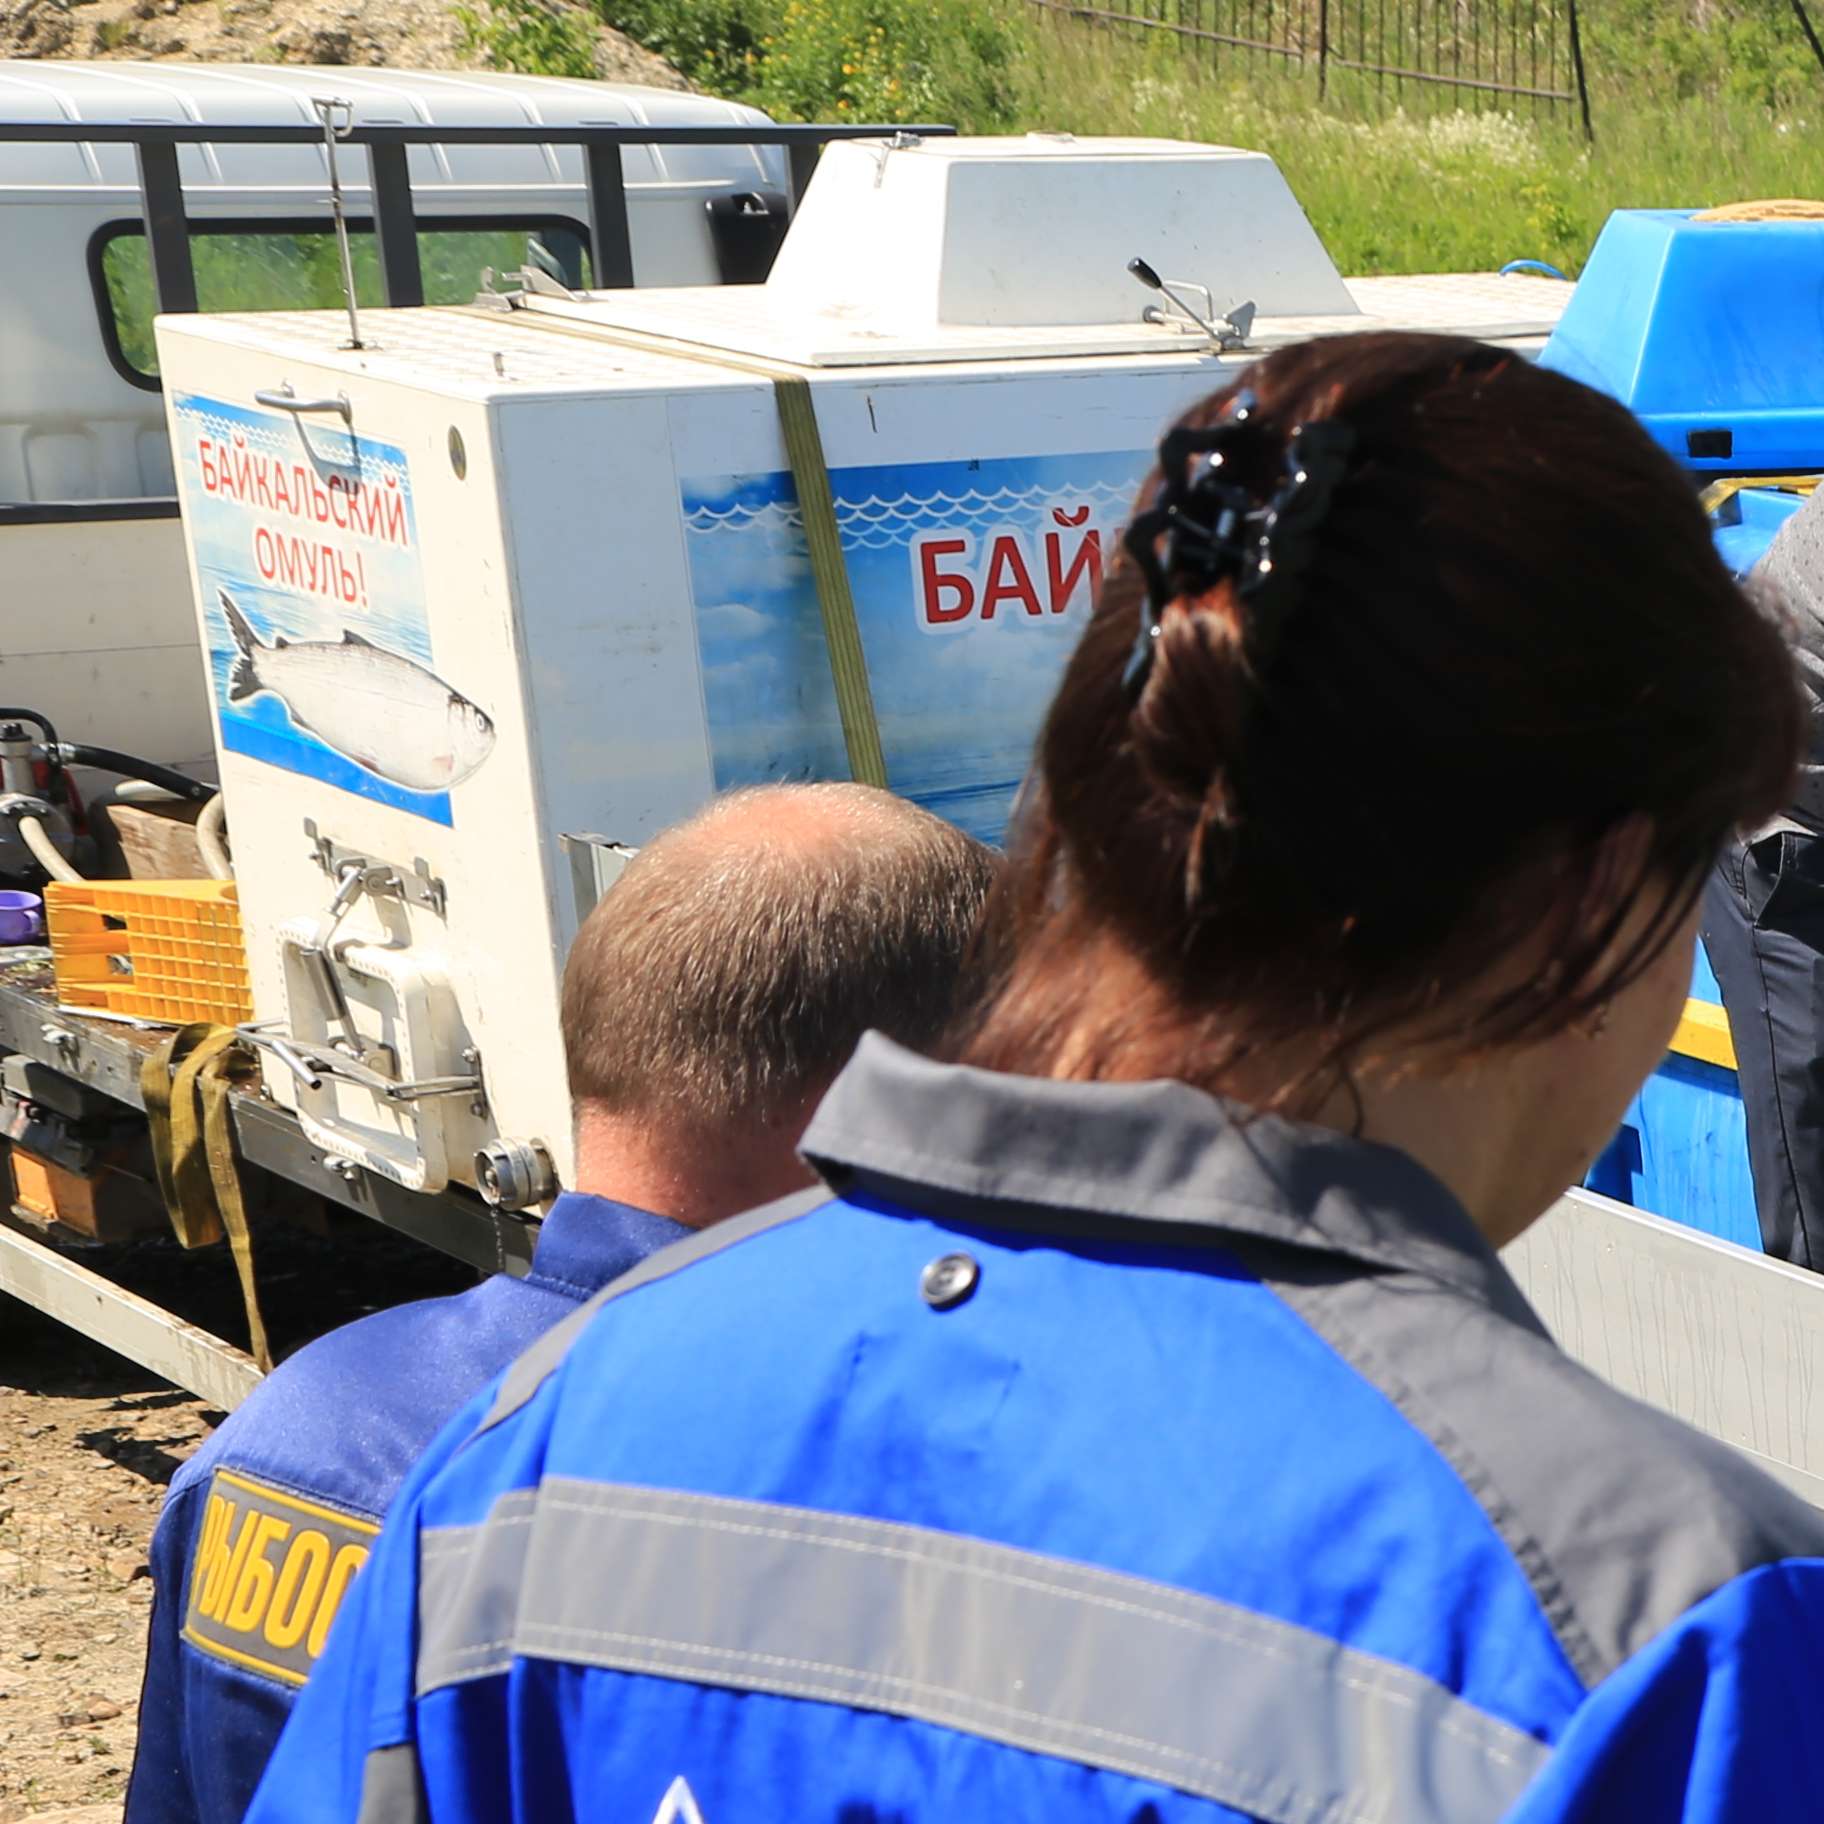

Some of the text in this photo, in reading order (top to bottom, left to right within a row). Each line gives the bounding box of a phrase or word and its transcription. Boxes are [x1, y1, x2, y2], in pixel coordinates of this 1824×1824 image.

[200, 433, 407, 546] БАЙКАЛЬСКИЙ
[255, 527, 367, 608] ОМУЛЬ!
[920, 506, 1123, 624] БАЙ
